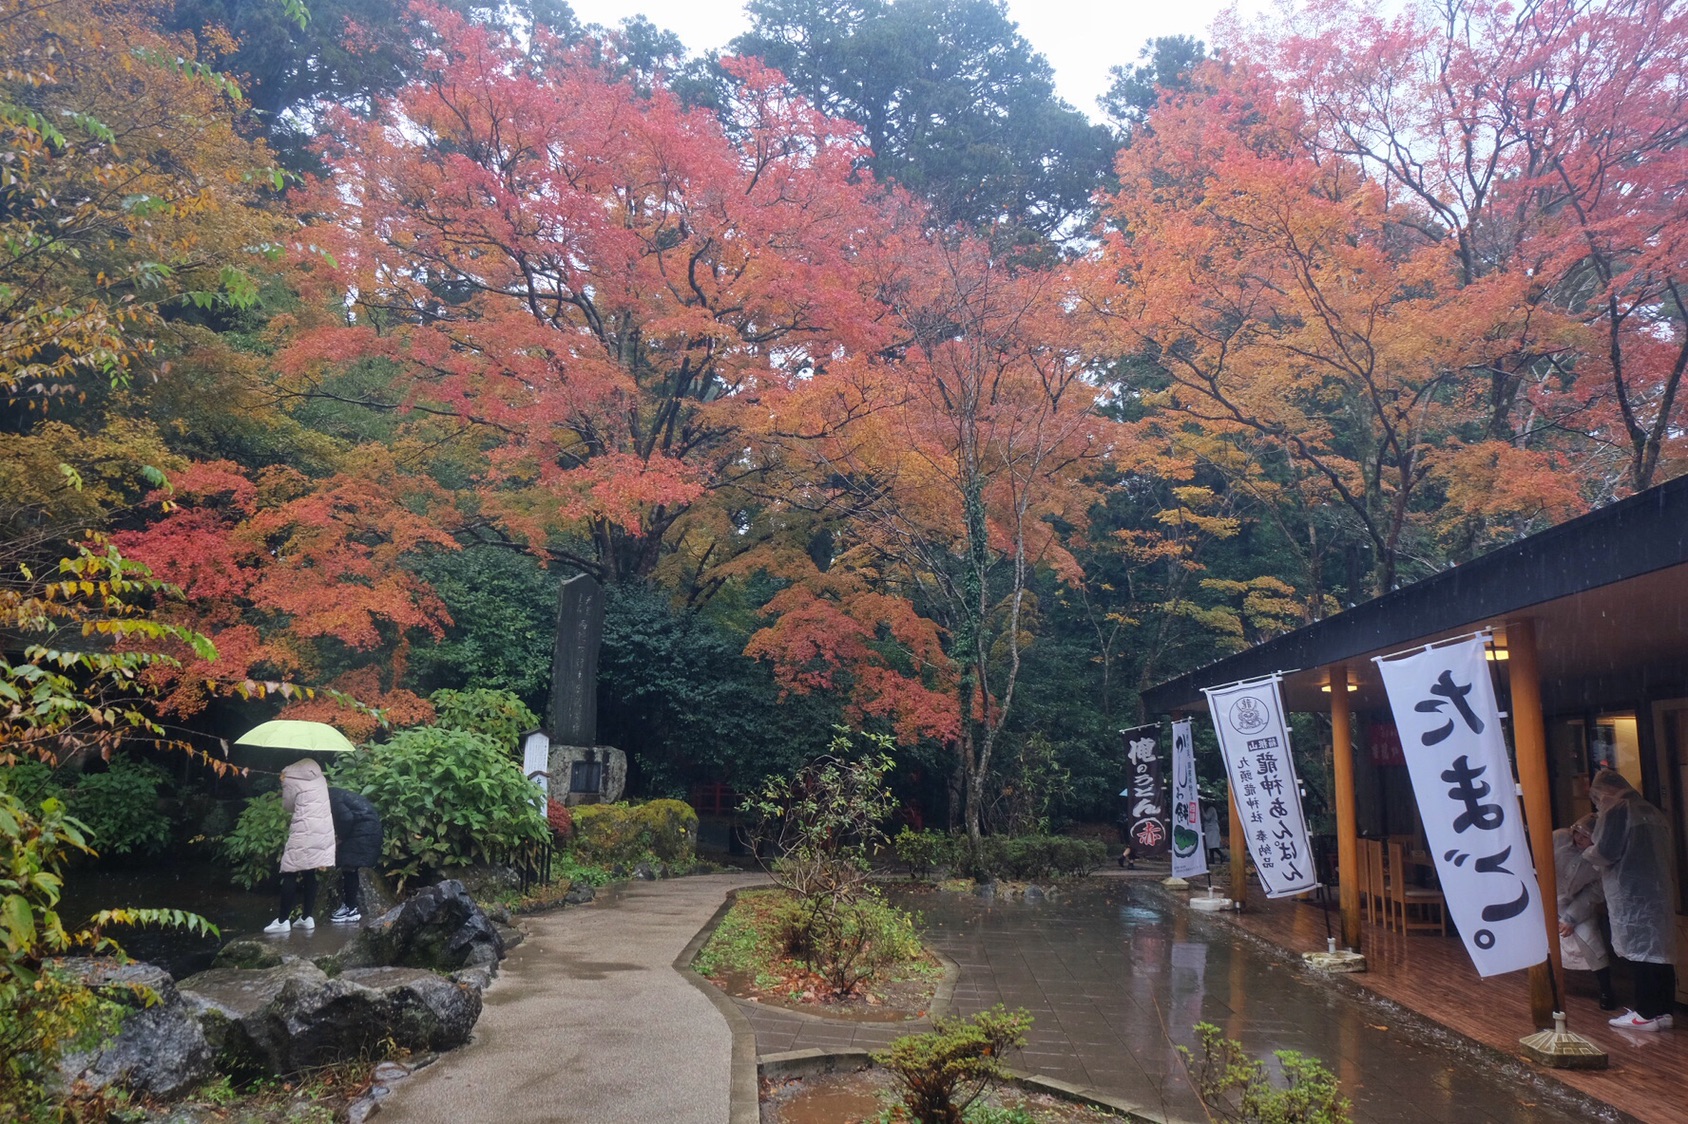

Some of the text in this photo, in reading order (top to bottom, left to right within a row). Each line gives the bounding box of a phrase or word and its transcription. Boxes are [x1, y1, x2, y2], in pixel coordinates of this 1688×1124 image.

[1127, 737, 1161, 818] 俺のうどん
[1175, 734, 1190, 825] かしわ餅
[1136, 821, 1163, 847] 赤
